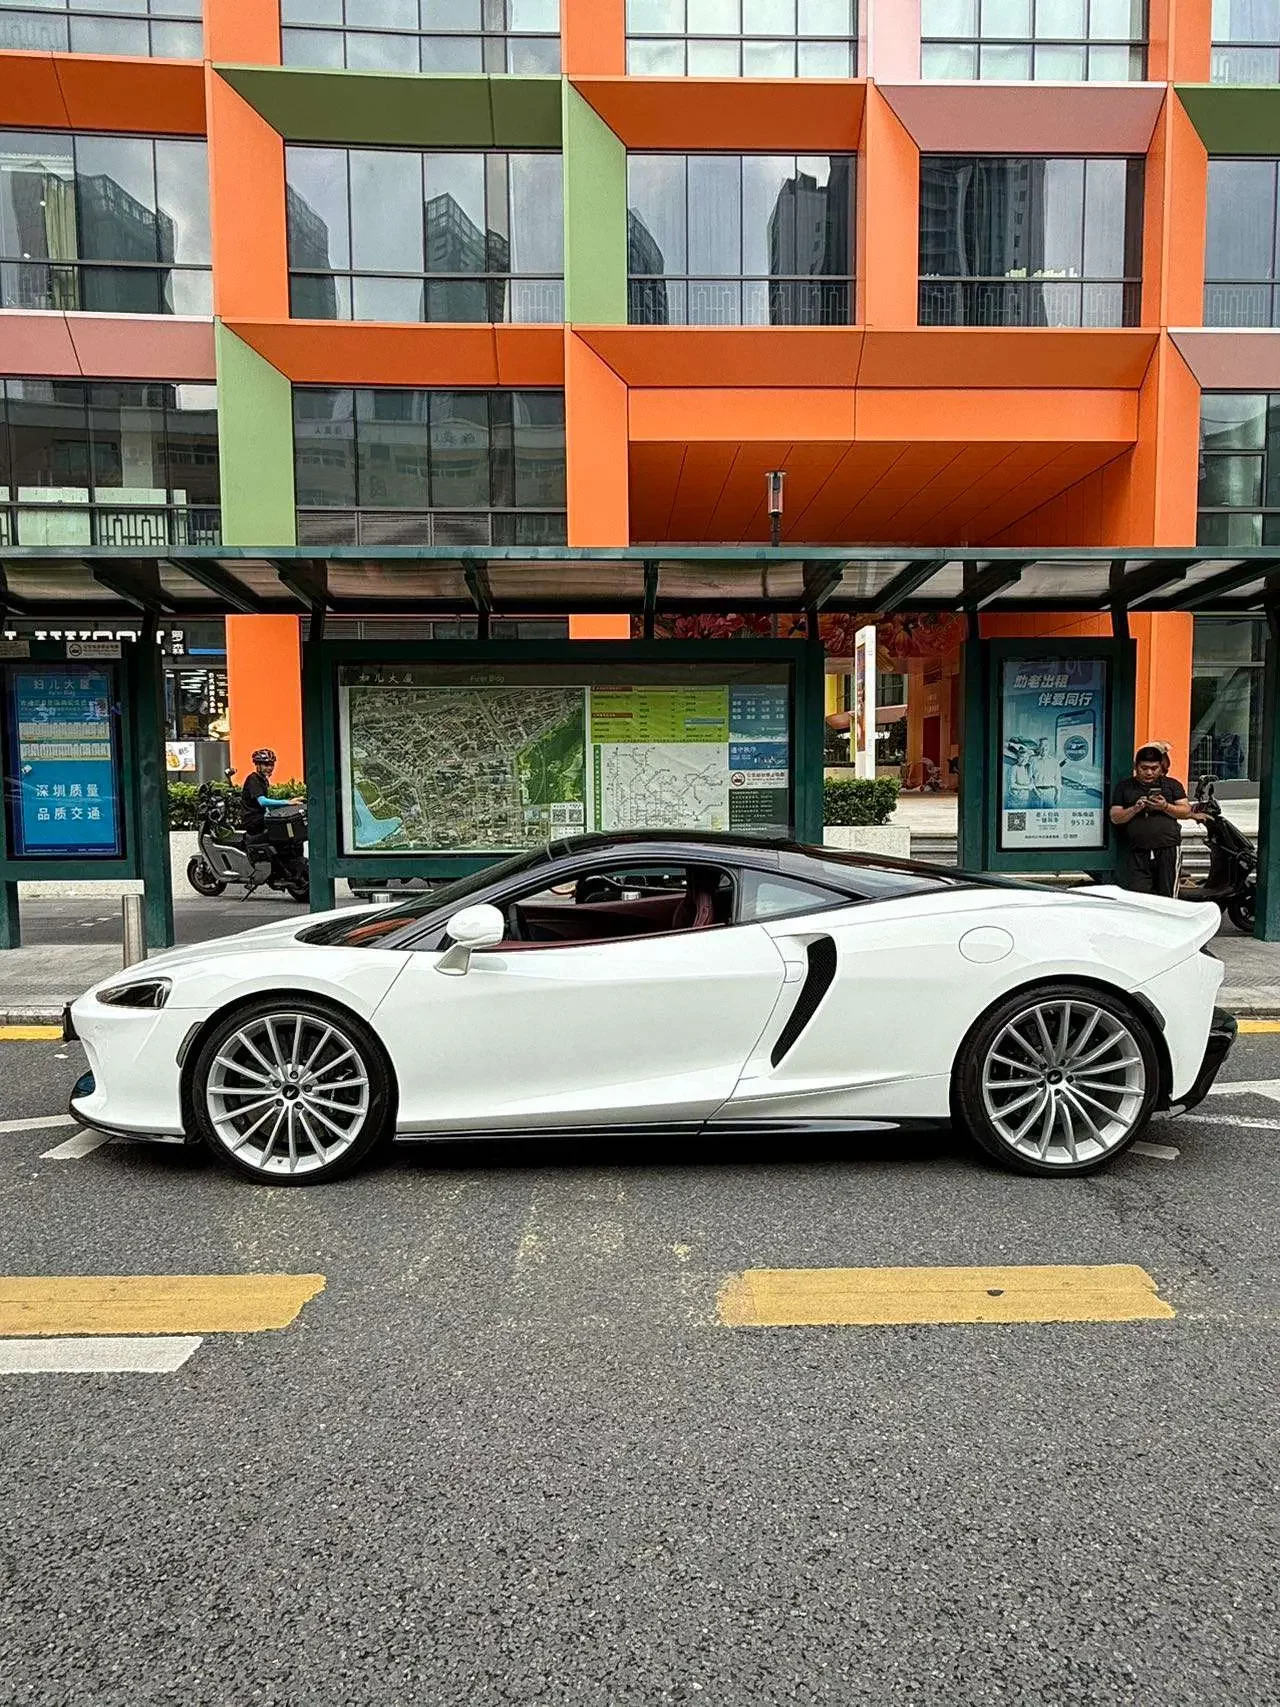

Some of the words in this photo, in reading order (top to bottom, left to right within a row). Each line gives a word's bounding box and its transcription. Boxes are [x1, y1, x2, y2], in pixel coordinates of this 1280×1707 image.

[1014, 674, 1068, 689] 助老出租
[1038, 692, 1093, 706] 伴爱同行
[36, 783, 99, 797] 深圳质量
[37, 806, 101, 821] 品质交通
